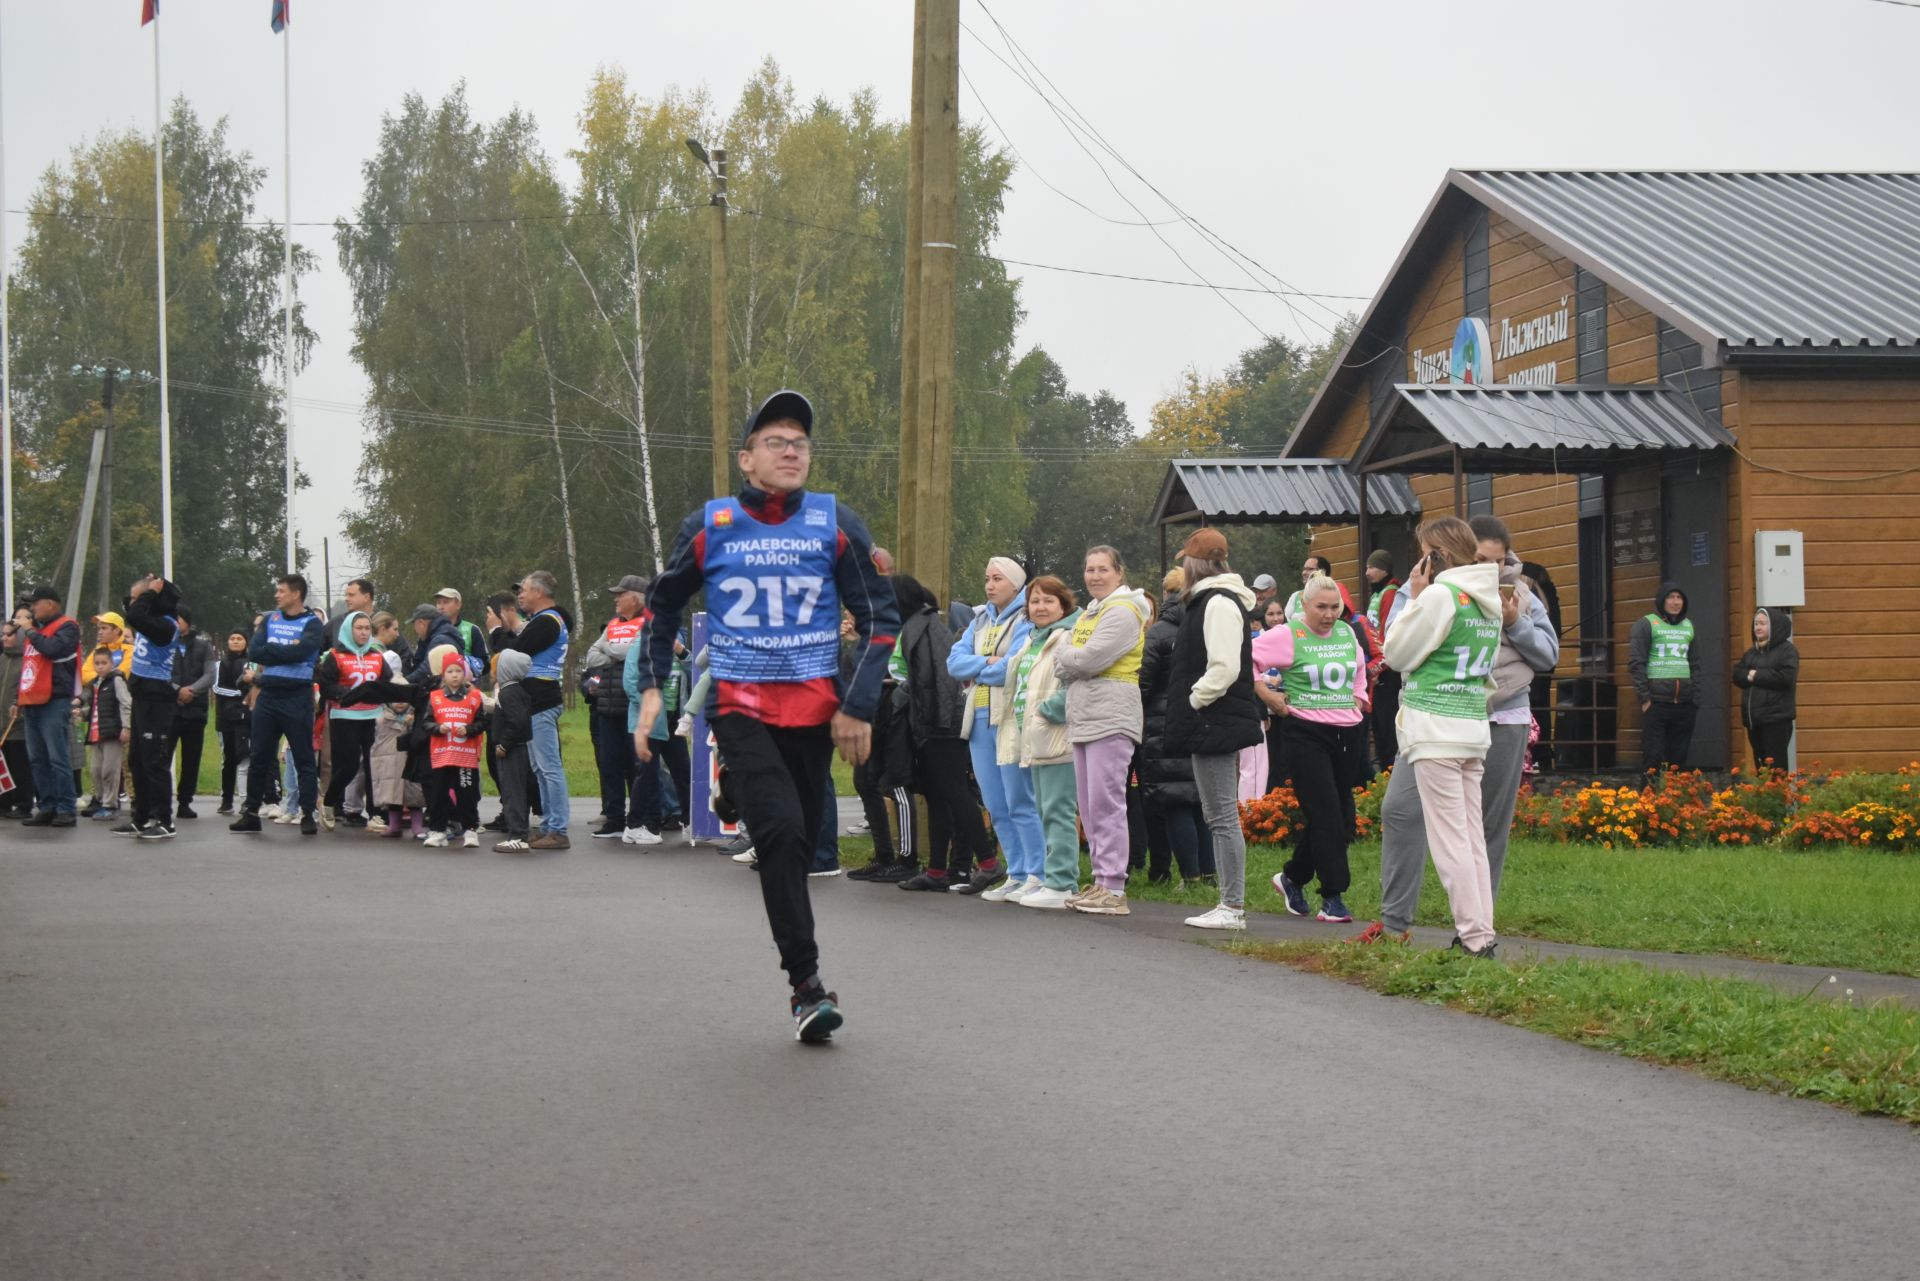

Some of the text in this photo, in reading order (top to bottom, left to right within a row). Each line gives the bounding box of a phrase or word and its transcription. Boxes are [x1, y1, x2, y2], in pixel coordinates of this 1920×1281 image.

[1498, 295, 1569, 360] Лыжный
[723, 537, 823, 555] ТУКАЕВСКИЙ
[744, 550, 800, 567] РАЙОН
[718, 575, 824, 628] 217
[753, 635, 800, 649] НОРМА
[800, 629, 838, 646] ЖИЗНИ
[1476, 627, 1497, 638] РАЙОН
[1303, 641, 1354, 653] ТУКАЕВСКИЙ
[1453, 645, 1497, 680] 14
